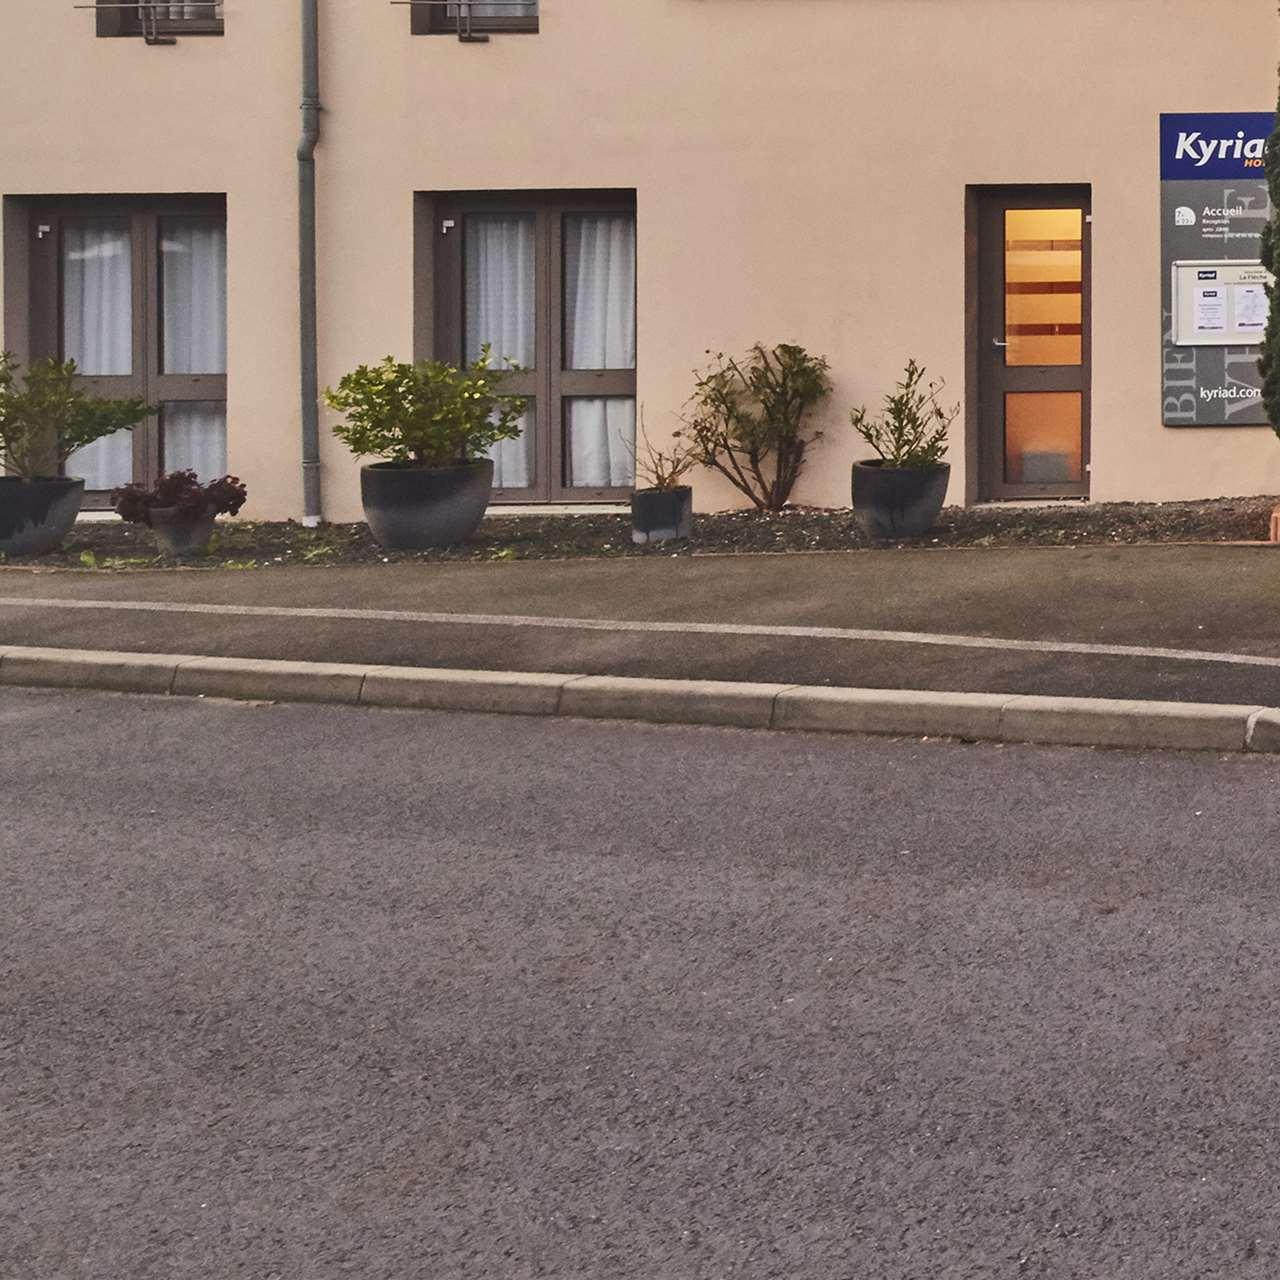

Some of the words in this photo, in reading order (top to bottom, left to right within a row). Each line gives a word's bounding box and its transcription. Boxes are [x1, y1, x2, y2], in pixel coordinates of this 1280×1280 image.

[1175, 131, 1268, 167] Kyria
[1244, 159, 1265, 167] HO
[1202, 206, 1242, 217] Accueil
